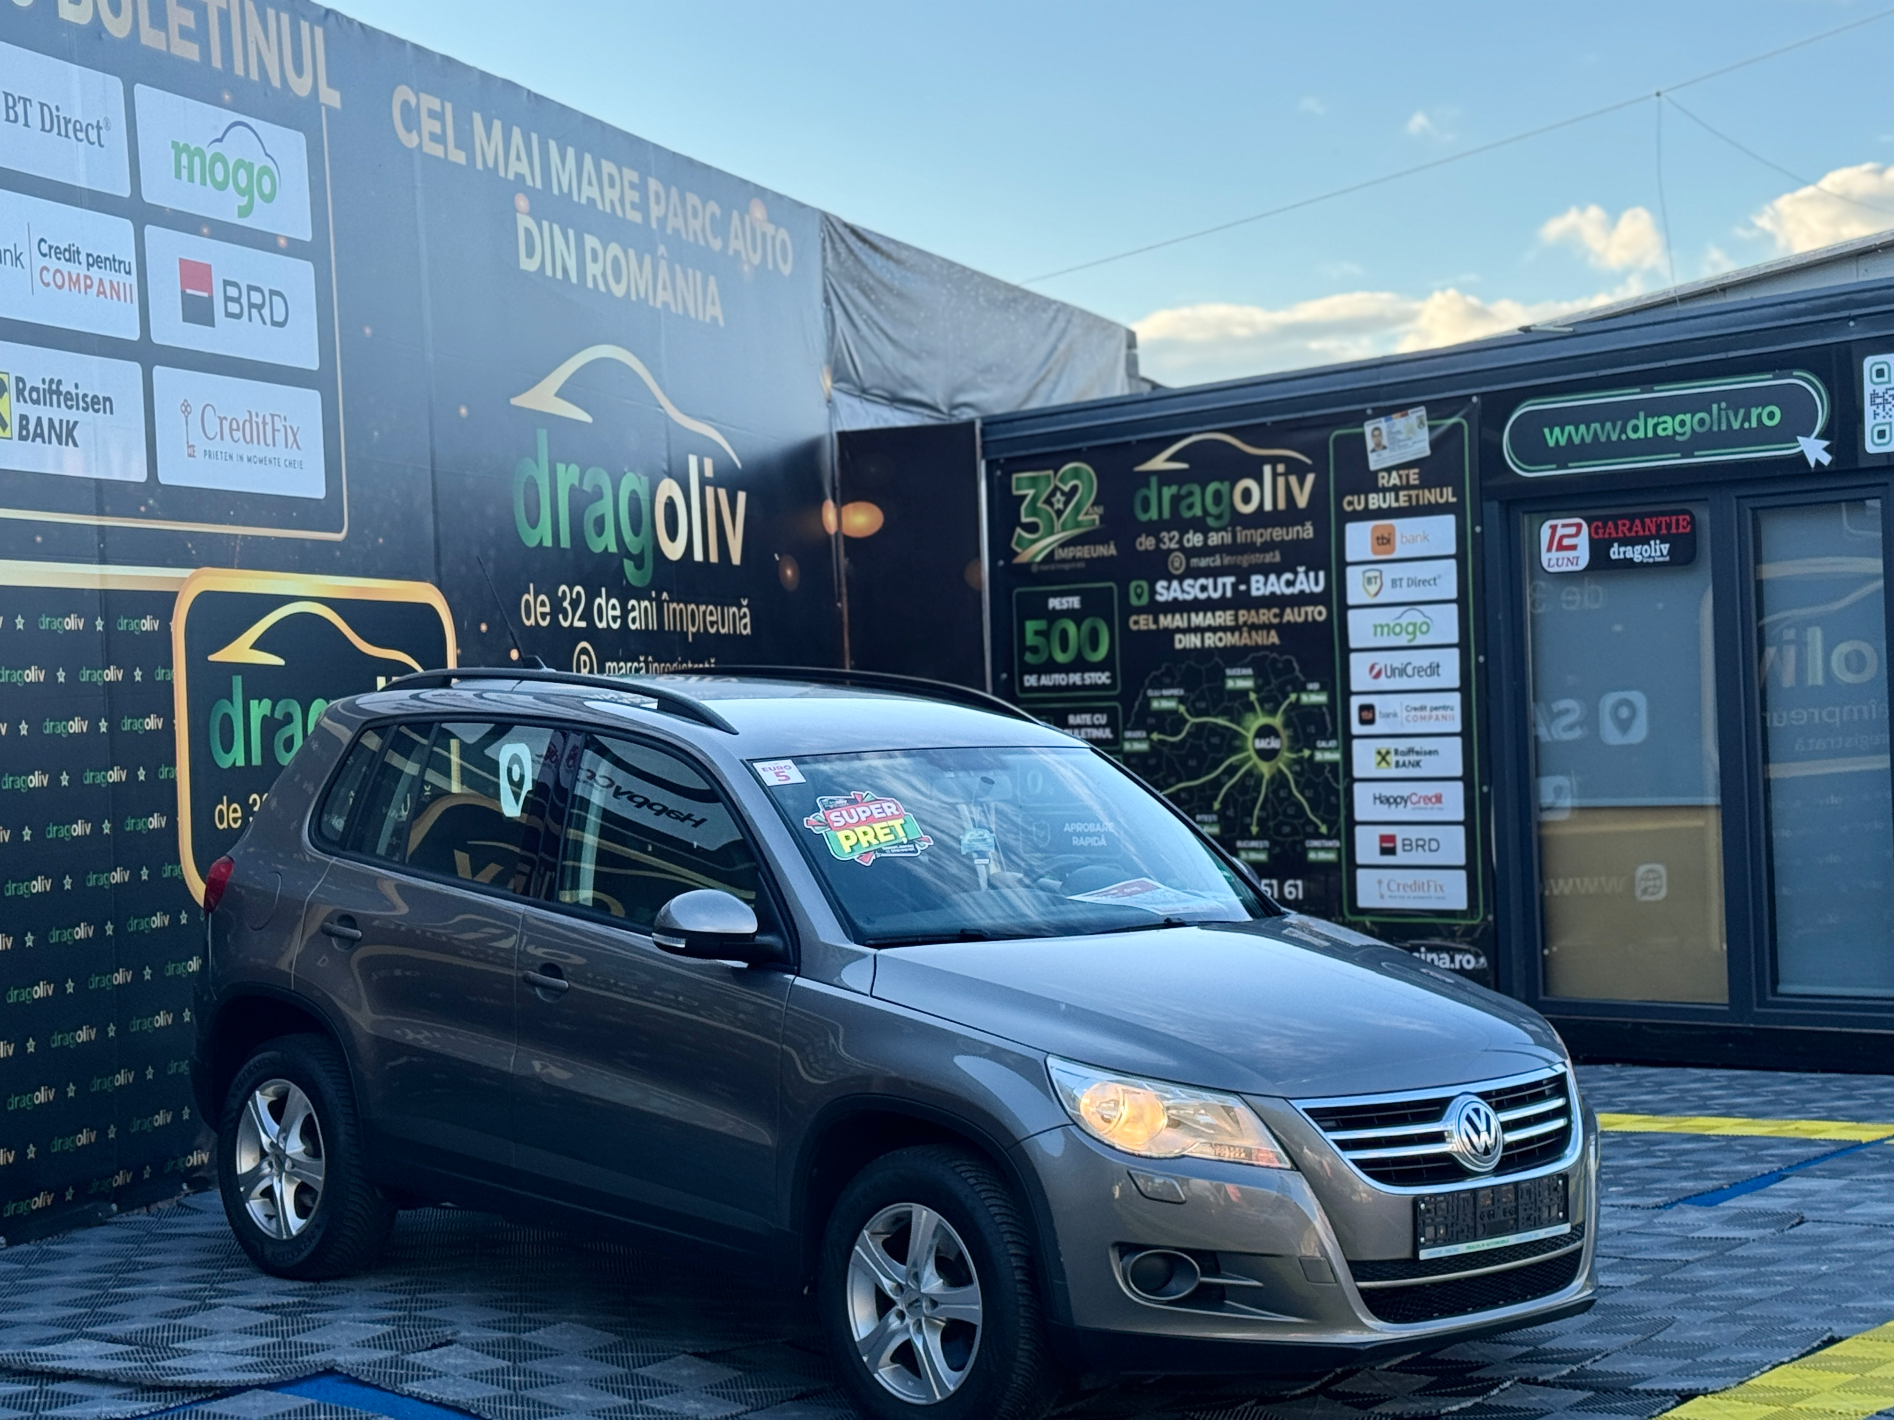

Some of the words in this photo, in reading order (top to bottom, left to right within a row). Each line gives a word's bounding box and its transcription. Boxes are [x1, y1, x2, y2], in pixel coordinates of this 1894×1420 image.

[58, 0, 342, 108] LETINUL
[2, 90, 32, 129] BT
[171, 140, 277, 219] mogo
[392, 84, 466, 166] CEL
[472, 111, 542, 190] MAI
[548, 139, 643, 224] MARE
[647, 176, 723, 252] PARC
[727, 209, 793, 276] AUTO
[0, 243, 25, 270] nk
[37, 238, 82, 266] Credit
[86, 253, 132, 276] pentru
[516, 212, 578, 284] DIN
[584, 244, 725, 328] ROMÂNIA
[39, 266, 133, 304] COMPANII
[222, 279, 289, 328] BRD
[15, 376, 114, 416] Raiffeisen
[18, 414, 79, 448] BANK
[200, 404, 301, 450] CreditFix
[1543, 401, 1781, 448] www.dragoliv.ro
[203, 449, 233, 462] PRIETEN
[246, 455, 281, 467] MOMENTE
[1378, 469, 1420, 488] RATE
[1133, 463, 1316, 528] dragoliv
[1343, 495, 1365, 511] CU
[1368, 487, 1457, 509] BULETINUL
[512, 428, 747, 587] dragoliv
[1011, 462, 1098, 553] 32
[1136, 534, 1156, 551] de
[1159, 531, 1180, 549] 32
[1183, 530, 1204, 547] de
[1207, 527, 1232, 546] ani
[1236, 521, 1314, 546] împreună
[1546, 522, 1583, 553] 12
[1590, 515, 1691, 538] GARANTIE
[1375, 533, 1391, 546] tbi
[1400, 531, 1430, 544] bank
[1547, 556, 1580, 568] LUNI
[1609, 540, 1670, 562] dragoliv
[1155, 576, 1235, 602] SASCUT
[1250, 566, 1325, 597] BACĂU
[1391, 577, 1403, 589] BT
[521, 583, 551, 627] de
[558, 584, 587, 628] 32
[593, 587, 622, 630] de
[627, 591, 657, 630] ani
[661, 591, 751, 643] împreună
[1048, 596, 1081, 610] PESTE
[38, 613, 85, 635] dragoliv
[117, 615, 160, 635] dragoliv
[1129, 614, 1157, 631] CEL
[1158, 612, 1188, 629] MAI
[1190, 611, 1235, 628] MARE
[1237, 608, 1281, 625] PARC
[1282, 605, 1327, 624] AUTO
[1024, 617, 1110, 665] 500
[1174, 633, 1201, 650] DIN
[1204, 628, 1280, 648] ROMÂNIA
[1373, 621, 1431, 643] mogo
[79, 665, 124, 685] dragoliv
[1023, 674, 1039, 687] DE
[1040, 673, 1068, 686] AUTO
[1068, 672, 1082, 685] PE
[1083, 671, 1112, 685] STOC
[1384, 661, 1441, 679] UniCredit
[1068, 714, 1092, 726] RATE
[1093, 713, 1107, 725] CU
[1405, 705, 1427, 713] Credit
[1429, 704, 1454, 714] pentru
[42, 716, 88, 737] dragoliv
[120, 714, 163, 734] dragoliv
[1394, 746, 1439, 757] Raiffeisen
[1394, 759, 1422, 769] BANK
[1, 770, 49, 792] dragoliv
[83, 765, 127, 787] dragoliv
[775, 771, 791, 782] 5
[1373, 792, 1443, 808] HappyCredit
[124, 813, 167, 834] dragoliv
[215, 796, 242, 830] de
[829, 802, 900, 828] SUPER
[45, 820, 92, 841] dragoliv
[836, 818, 907, 854] PREȚ
[1402, 838, 1440, 852] BRD
[4, 876, 52, 898] dragoliv
[86, 867, 130, 888] dragoliv
[1387, 879, 1445, 893] CreditFix
[1283, 879, 1303, 900] 61
[49, 922, 95, 945] dragoliv
[127, 912, 170, 933] dragoliv
[87, 968, 133, 991] dragoliv
[6, 981, 54, 1004] dragoliv
[129, 1010, 174, 1033] dragoliv
[50, 1025, 97, 1048] dragoliv
